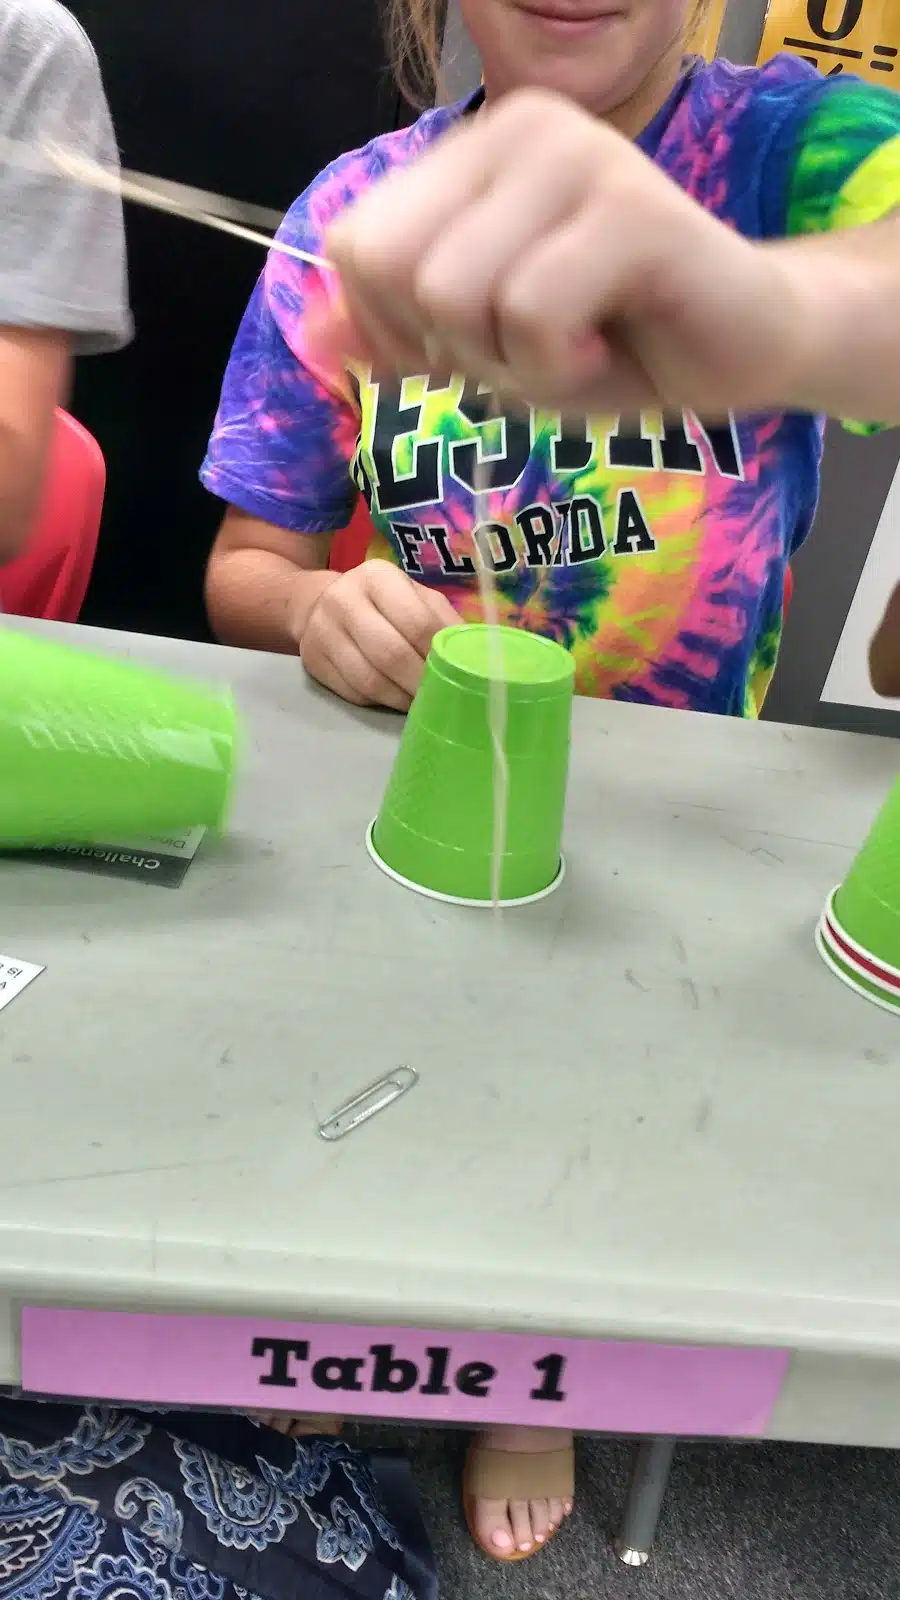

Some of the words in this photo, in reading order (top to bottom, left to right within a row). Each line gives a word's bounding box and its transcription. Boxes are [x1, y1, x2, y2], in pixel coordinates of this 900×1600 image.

[389, 487, 657, 575] FLORIDA
[251, 1337, 497, 1397] Table
[529, 1353, 567, 1401] 1
